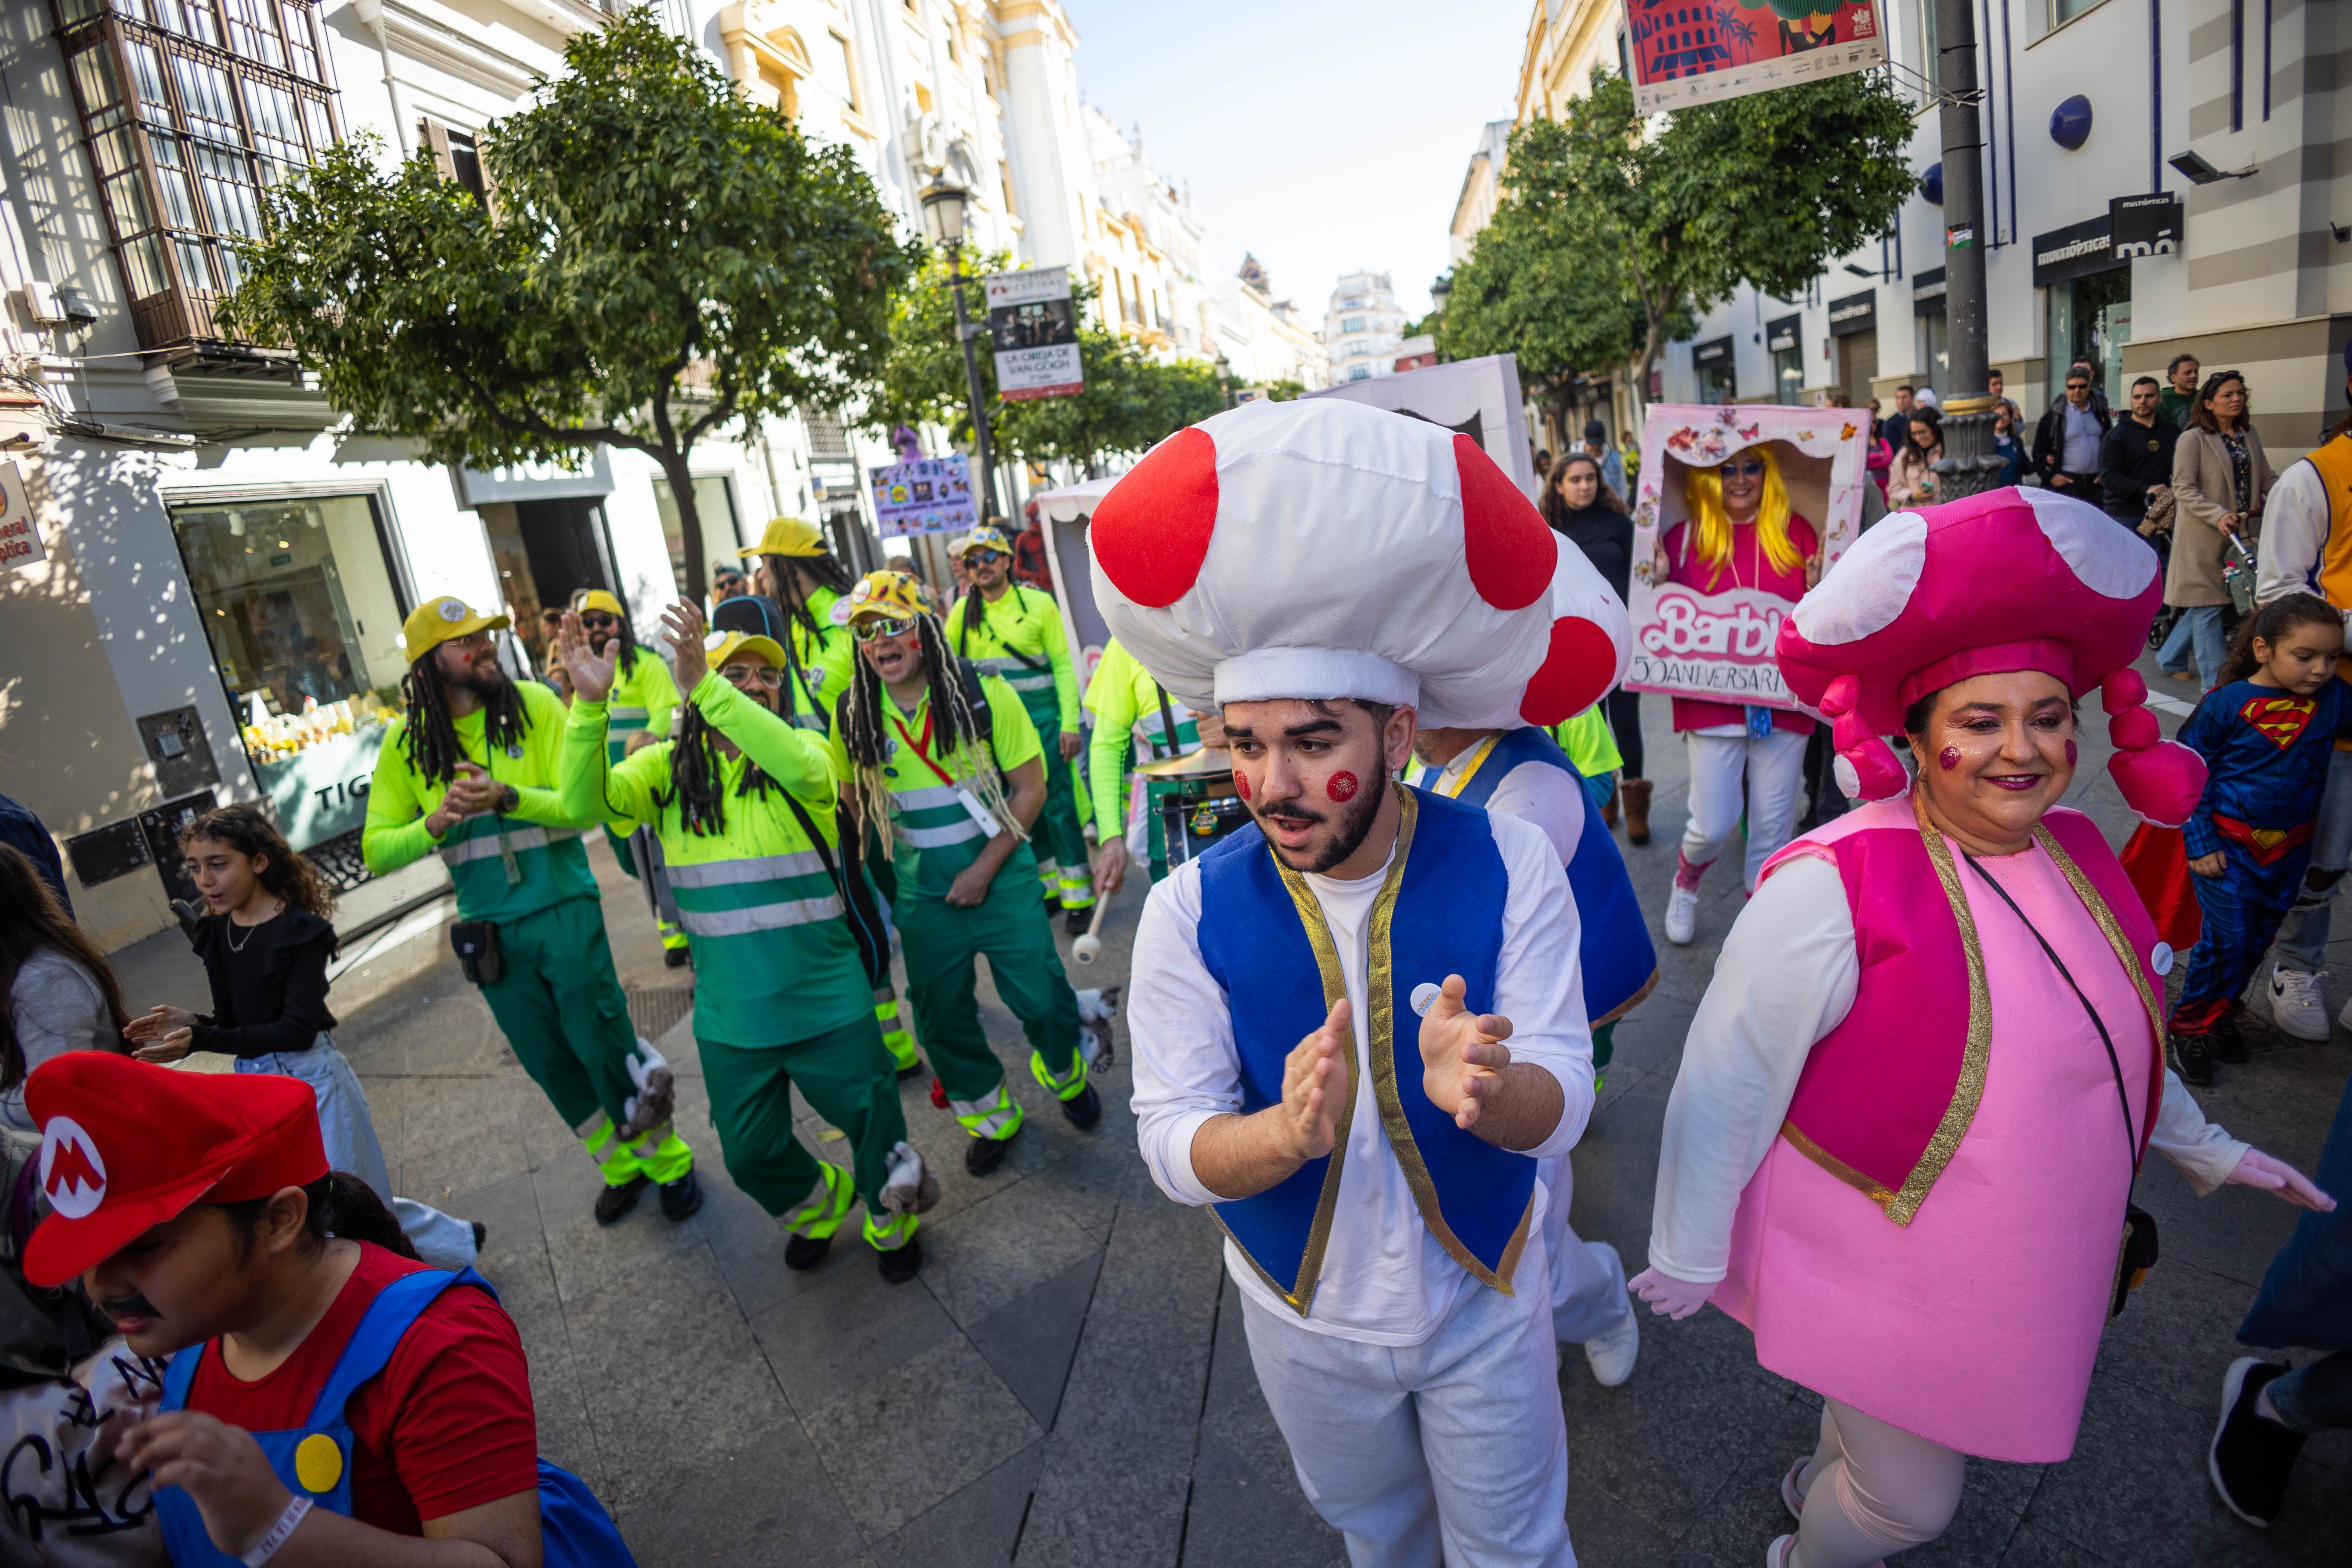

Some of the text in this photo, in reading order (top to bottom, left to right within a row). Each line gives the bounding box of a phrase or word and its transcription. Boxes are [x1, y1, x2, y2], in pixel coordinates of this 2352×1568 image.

[1854, 23, 1872, 32] JEREZ
[1004, 354, 1019, 364] LA
[315, 771, 374, 812] TIG
[1418, 993, 1434, 1010] JEREZ
[46, 1136, 105, 1197] M
